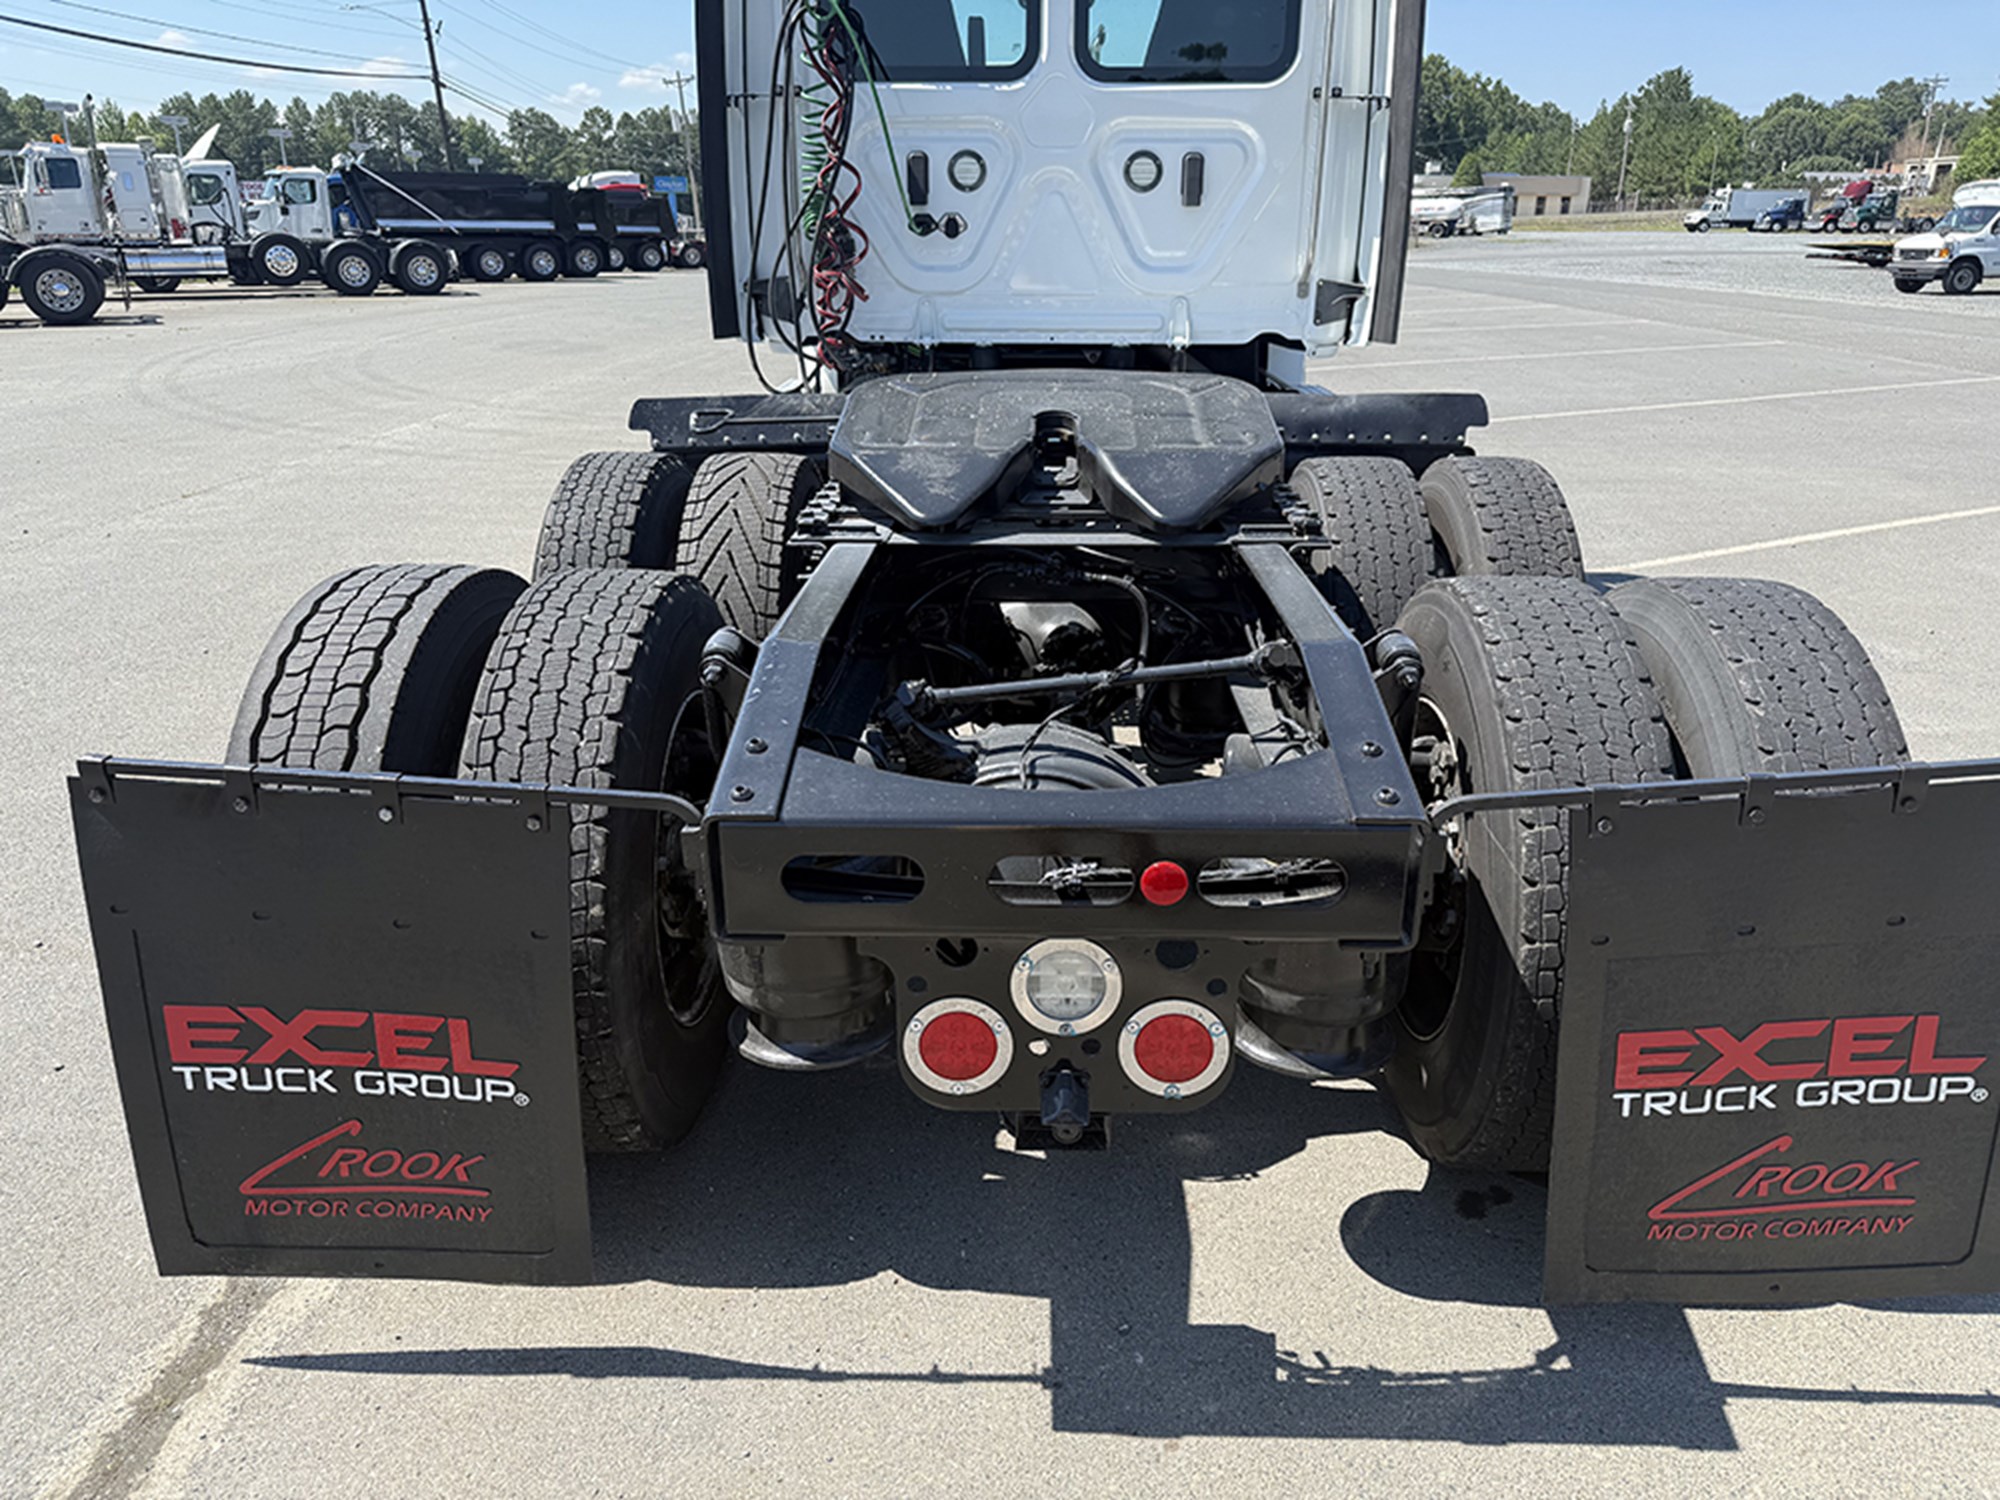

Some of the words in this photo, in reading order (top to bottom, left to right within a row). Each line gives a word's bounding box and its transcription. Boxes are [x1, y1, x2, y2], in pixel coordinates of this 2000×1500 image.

[163, 1005, 520, 1078] EXCEL
[1614, 1015, 1987, 1090] EXCEL
[171, 1066, 339, 1093] TRUCK
[1612, 1084, 1778, 1118] TRUCK
[244, 1199, 349, 1217] MOTOR
[356, 1201, 493, 1222] COMPANY
[1647, 1223, 1760, 1241] MOTOR
[1764, 1217, 1914, 1239] COMPANY
